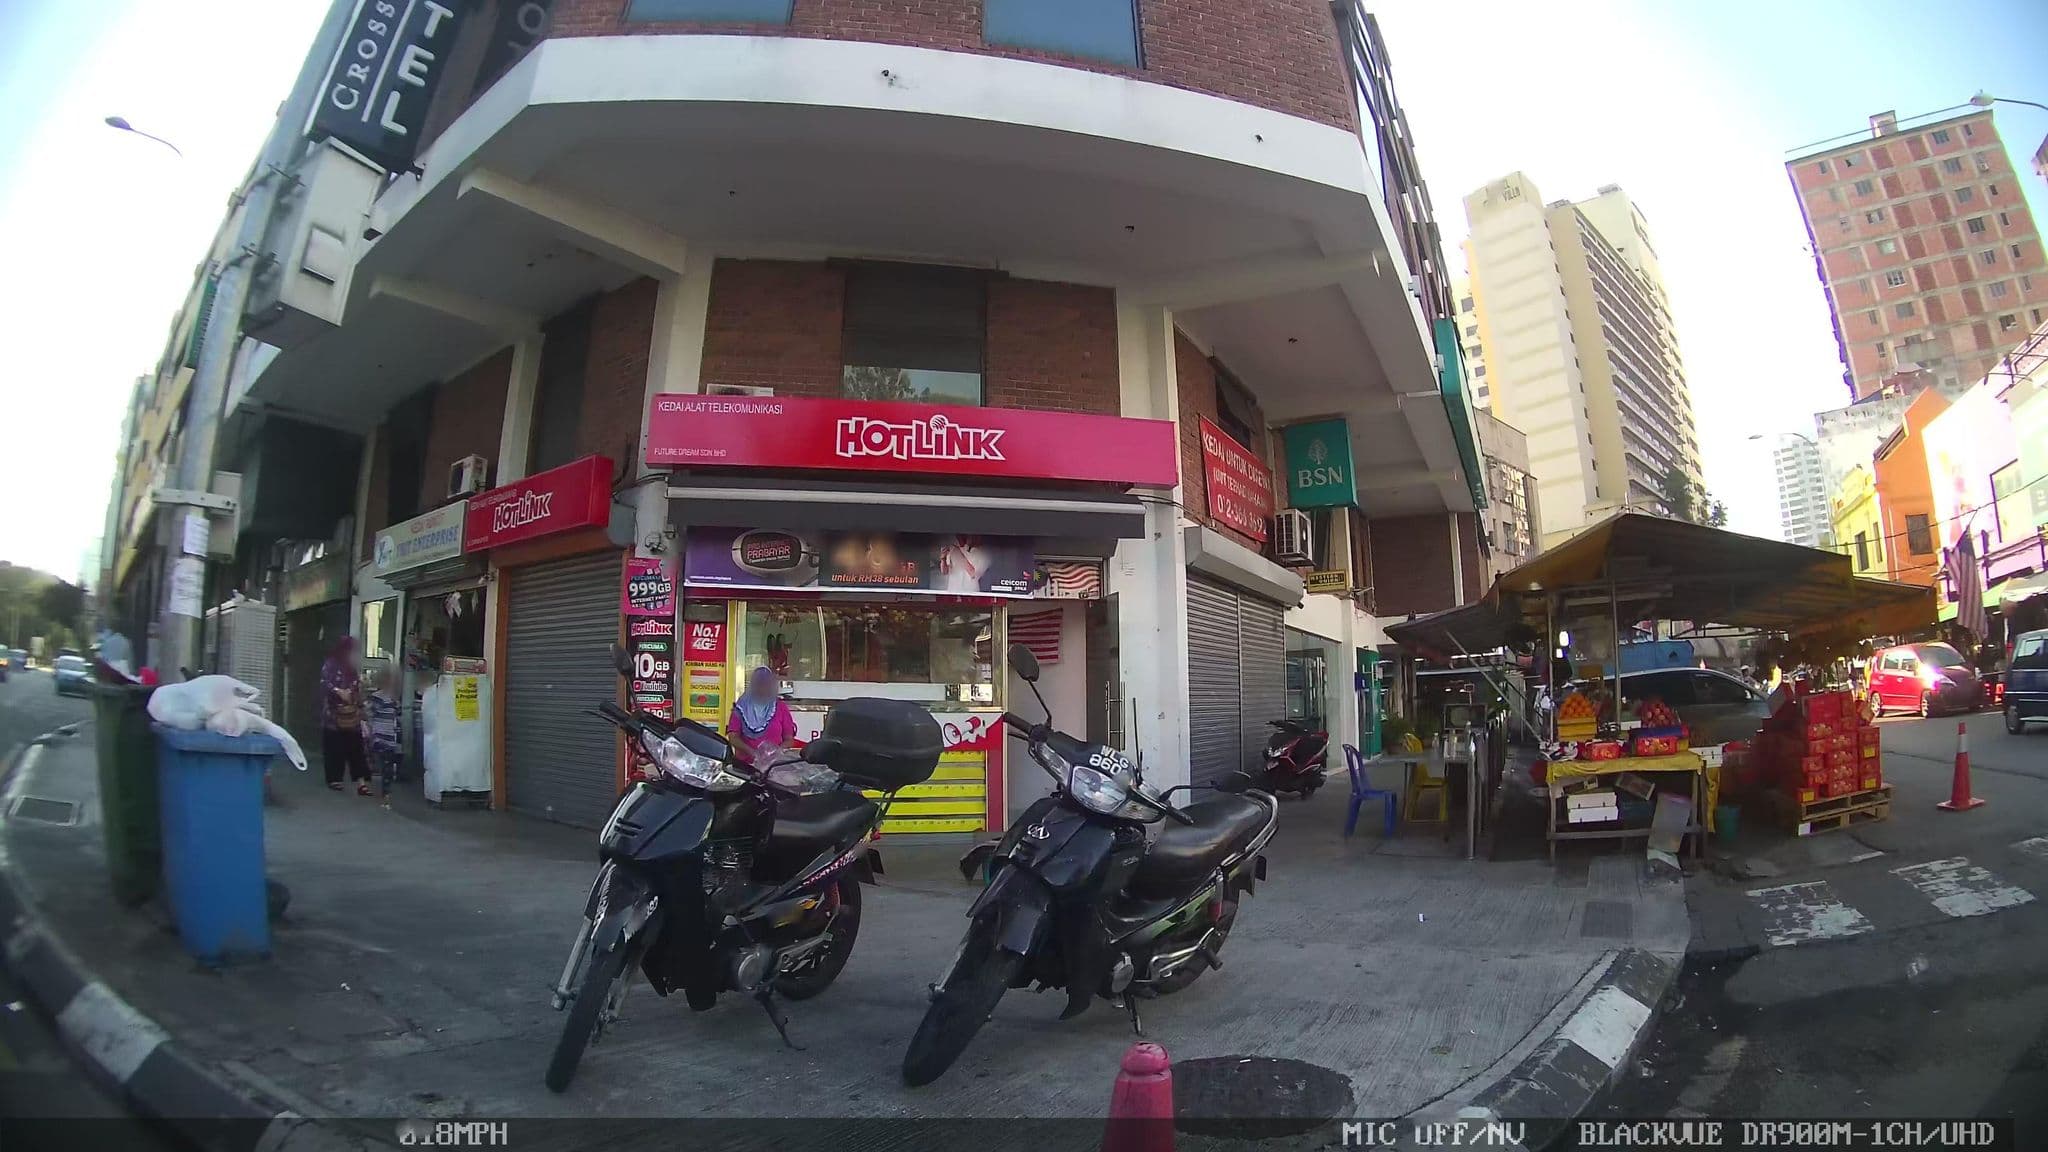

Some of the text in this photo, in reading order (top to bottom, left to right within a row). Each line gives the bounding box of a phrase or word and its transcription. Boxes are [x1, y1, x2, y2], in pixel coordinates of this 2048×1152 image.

[658, 401, 783, 414] KEDAI ALAT TELEKOMUNIKASI
[654, 447, 678, 456] FUTURE
[678, 448, 700, 456] DREAM
[1202, 431, 1225, 462] KEDAI
[1298, 466, 1344, 488] BSN
[747, 545, 791, 559] PRABAYAR
[831, 573, 919, 584] untuk RM38 sebulan
[692, 623, 721, 638] No.1
[633, 653, 670, 679] 10 GB
[640, 680, 668, 692] YouTube
